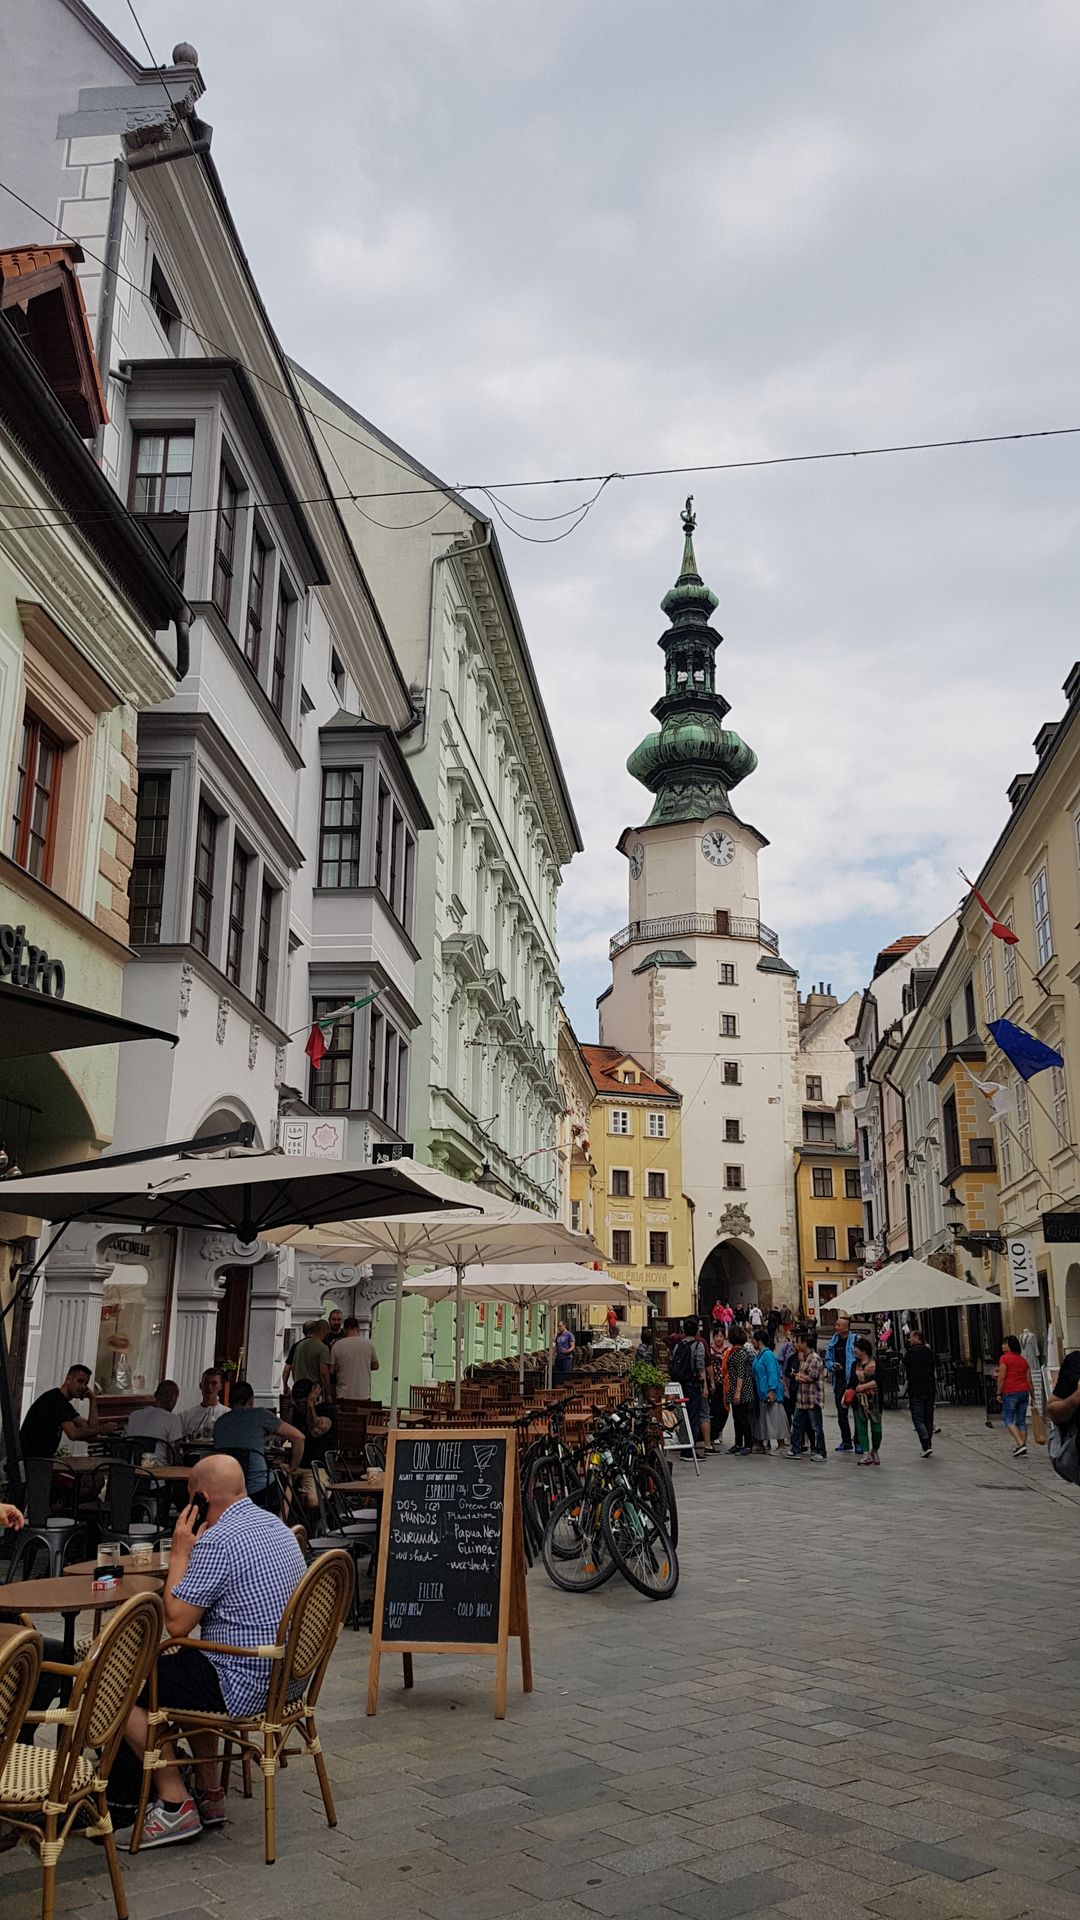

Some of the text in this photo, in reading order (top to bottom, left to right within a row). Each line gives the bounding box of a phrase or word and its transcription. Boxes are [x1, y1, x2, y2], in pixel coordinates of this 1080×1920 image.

[1011, 1243, 1030, 1292] IVKO
[645, 1272, 668, 1284] NOVA
[413, 1442, 462, 1470] OUR COFFEE
[425, 1484, 456, 1499] ESPRESSO
[396, 1500, 418, 1511] DOS
[459, 1498, 488, 1510] Green
[400, 1511, 437, 1525] MUNDOS
[454, 1522, 501, 1543] Papua New
[418, 1582, 444, 1599] FILTER
[457, 1602, 493, 1617] COLD BREW
